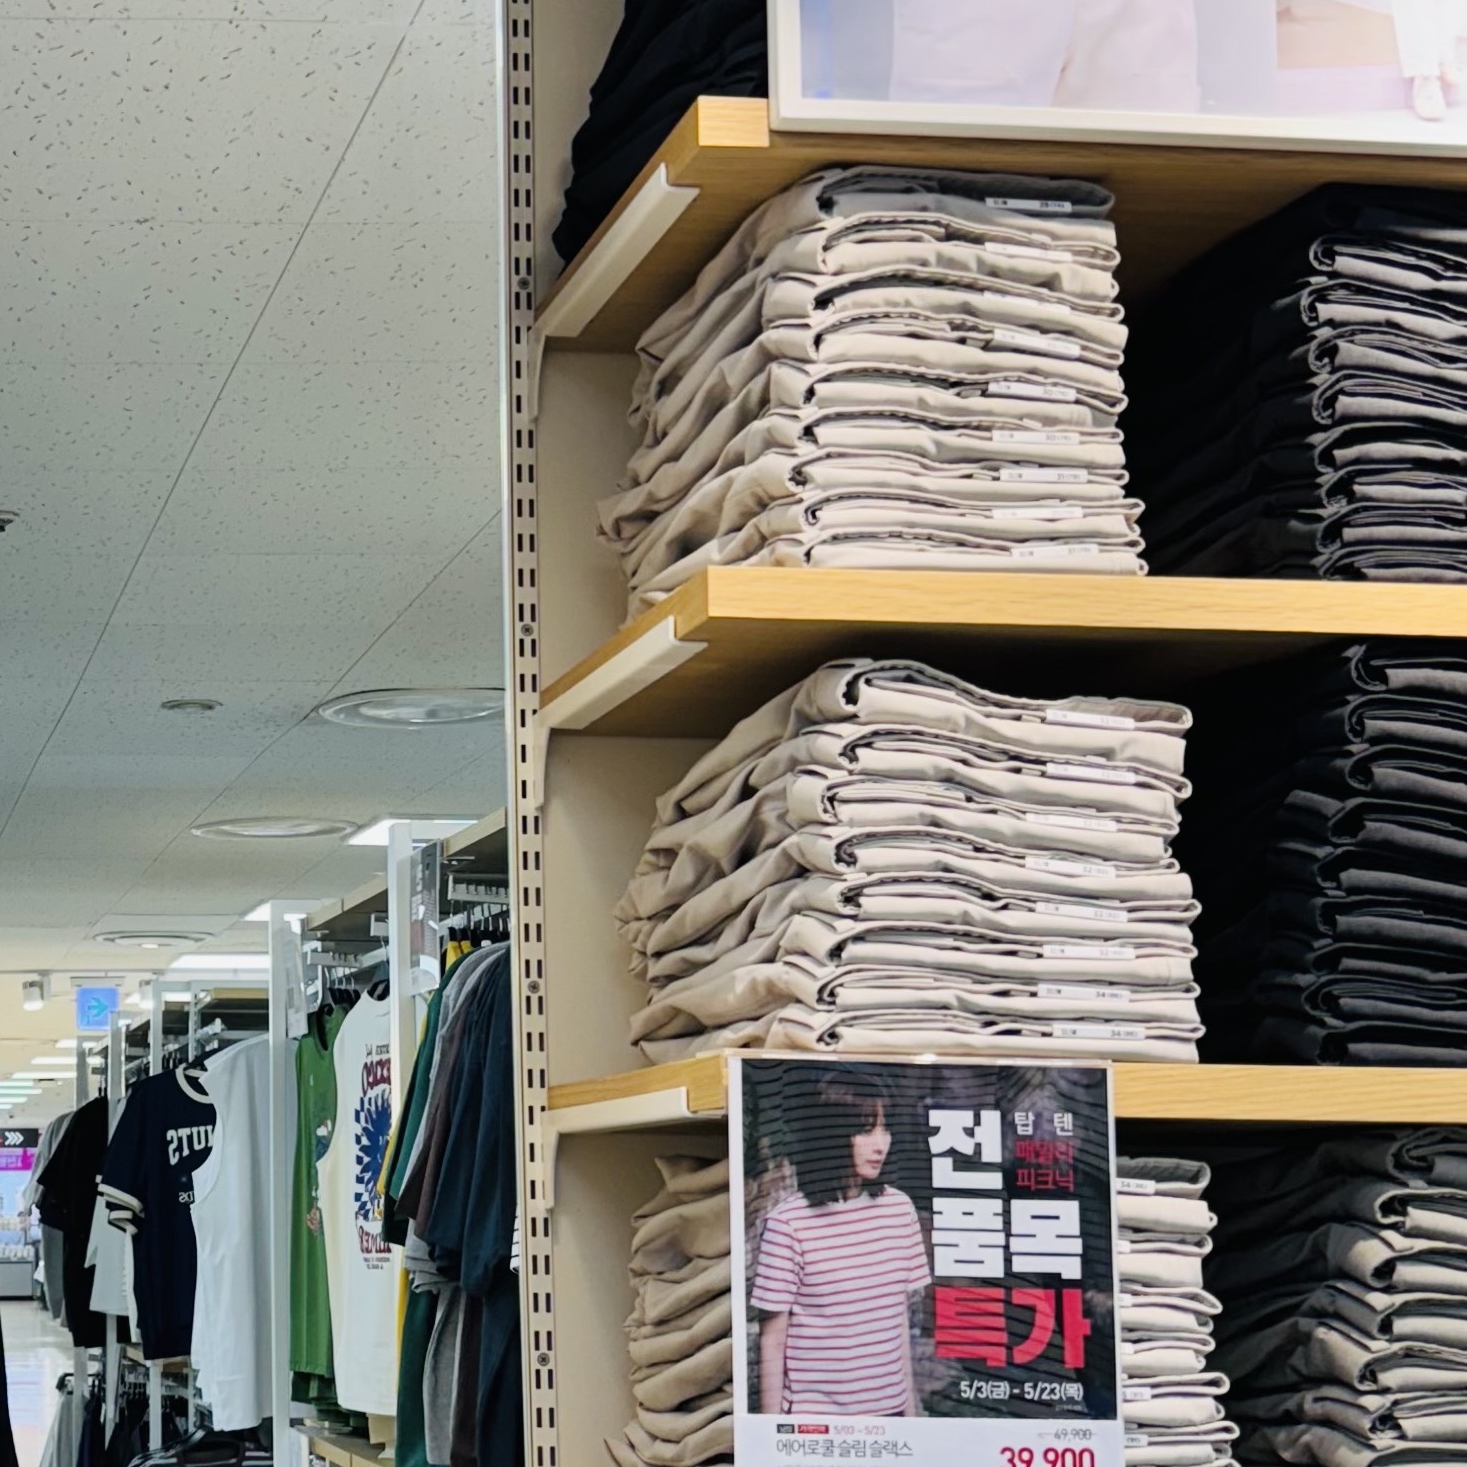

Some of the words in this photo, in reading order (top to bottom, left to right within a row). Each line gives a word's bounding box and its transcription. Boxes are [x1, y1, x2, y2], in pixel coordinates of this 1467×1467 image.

[928, 1109, 1003, 1190] 전
[1016, 1168, 1074, 1194] 피크닉
[931, 1198, 1083, 1280] 품목
[935, 1287, 1092, 1369] 특가
[960, 1379, 1010, 1399] 5/3(금)
[1024, 1381, 1084, 1401] 5/23(목)
[776, 1438, 835, 1458] 에어로쿨
[838, 1439, 867, 1458] 슬림
[869, 1439, 914, 1458] 슬랙스
